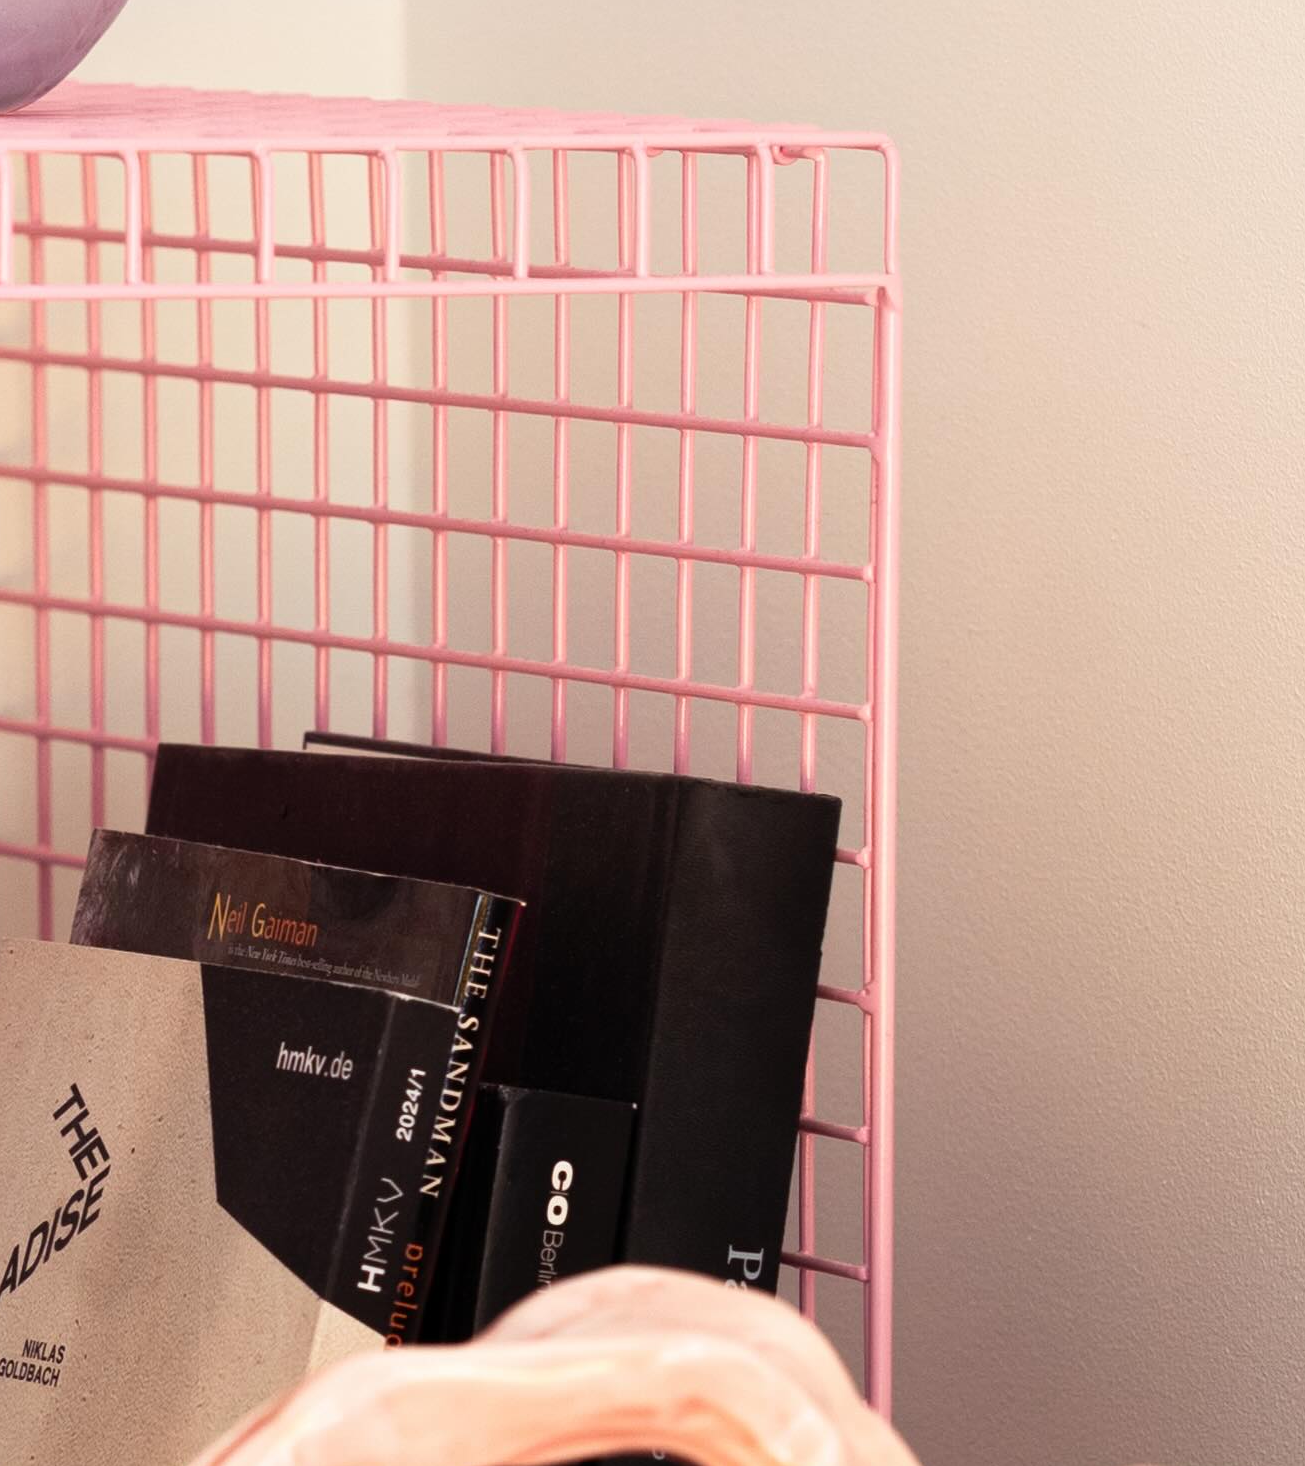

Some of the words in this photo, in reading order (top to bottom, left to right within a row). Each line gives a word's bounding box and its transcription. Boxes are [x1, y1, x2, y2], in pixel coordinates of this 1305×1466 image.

[207, 892, 247, 942] Neil
[251, 903, 318, 947] Gaiman
[464, 928, 502, 1000] THE
[276, 1042, 354, 1081] hmkv.de
[53, 1083, 110, 1181] THE
[396, 1068, 426, 1142] 2024/1
[419, 1013, 479, 1198] SANDMAN
[357, 1177, 404, 1293] HMKV
[384, 1243, 424, 1351] prelud
[22, 1338, 66, 1364] NIKLAS
